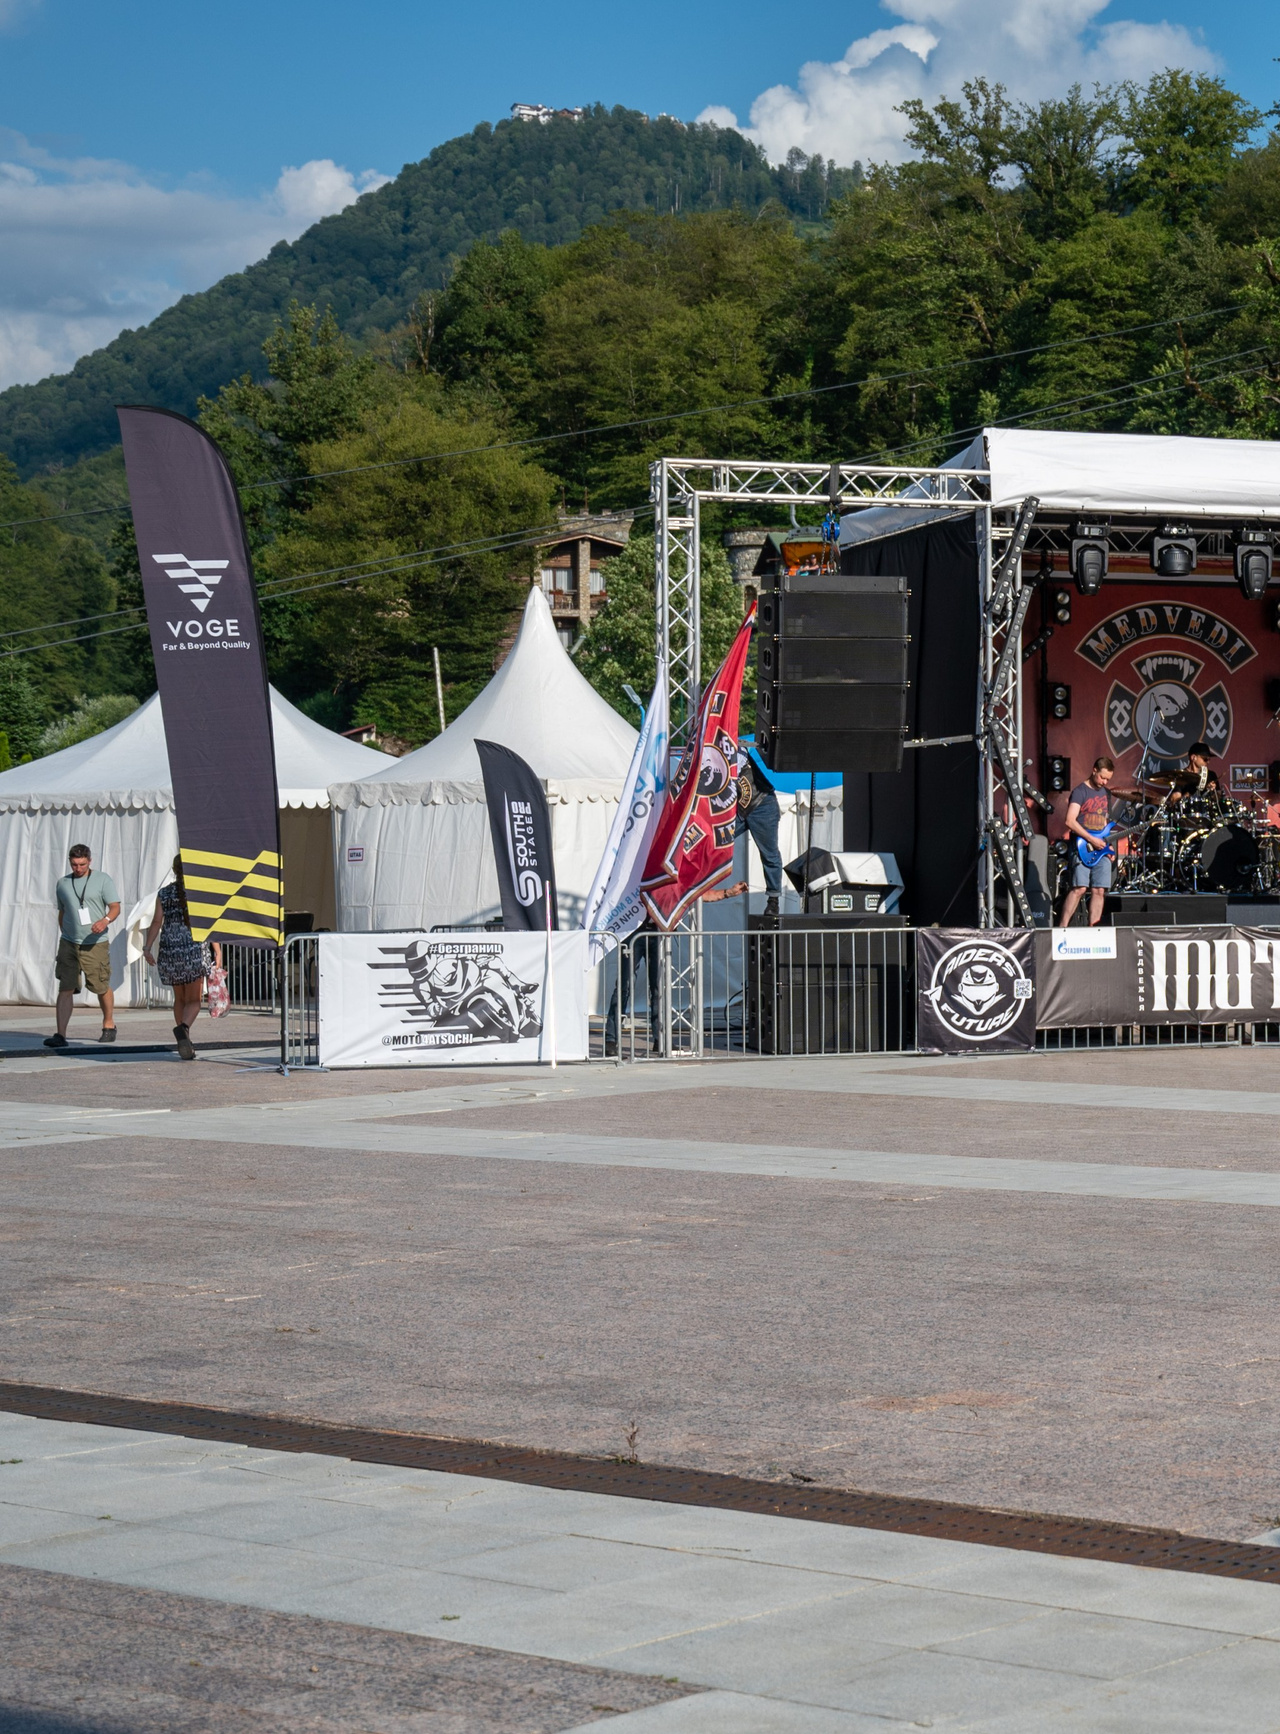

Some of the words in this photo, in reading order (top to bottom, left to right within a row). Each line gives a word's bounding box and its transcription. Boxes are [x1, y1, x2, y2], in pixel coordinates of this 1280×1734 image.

[166, 619, 240, 638] VOGE
[1085, 606, 1246, 663] MEDVEDI
[162, 643, 178, 651] Far
[179, 642, 187, 650] &
[187, 641, 221, 651] Beyond
[221, 641, 251, 650] Quality
[512, 814, 529, 867] SOUTH
[525, 816, 538, 867] STAGE
[429, 943, 502, 955] #безграниц
[942, 948, 1017, 983] RIDERS
[1137, 940, 1145, 1012] МЕДВЕЖЬЯ
[940, 1000, 1018, 1032] FUTURE
[381, 1033, 474, 1046] @MOTO4ATSOCHI
